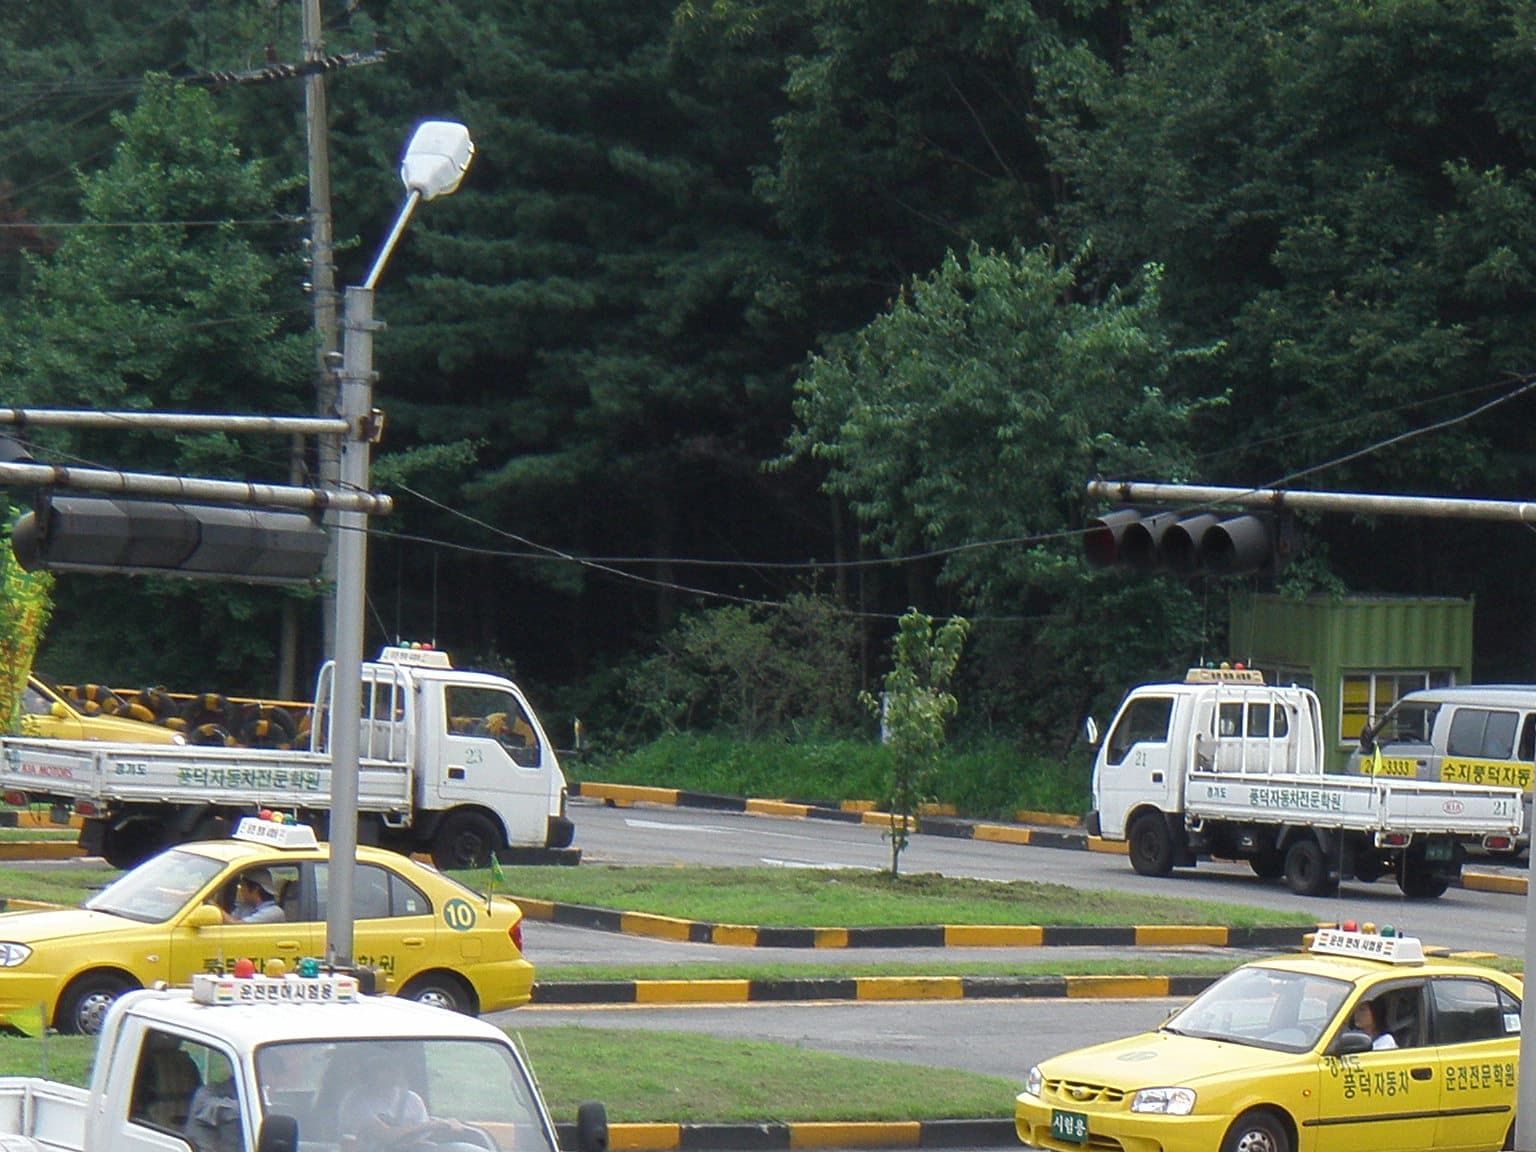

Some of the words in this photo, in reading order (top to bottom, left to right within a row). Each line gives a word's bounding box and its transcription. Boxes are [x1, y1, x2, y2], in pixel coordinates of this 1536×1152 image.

[465, 748, 483, 764] 23
[1135, 751, 1146, 767] 21
[1364, 759, 1409, 776] 2-3333
[176, 767, 320, 791] 풍덕자동차전문학원
[1250, 788, 1342, 810] 풍덕자동차전문학원
[1493, 801, 1507, 816] 21
[447, 903, 471, 926] 10
[1344, 1070, 1409, 1099] 풍덕자동차
[1446, 1063, 1515, 1091] 운전전문학원
[1053, 1115, 1087, 1137] 시험용
